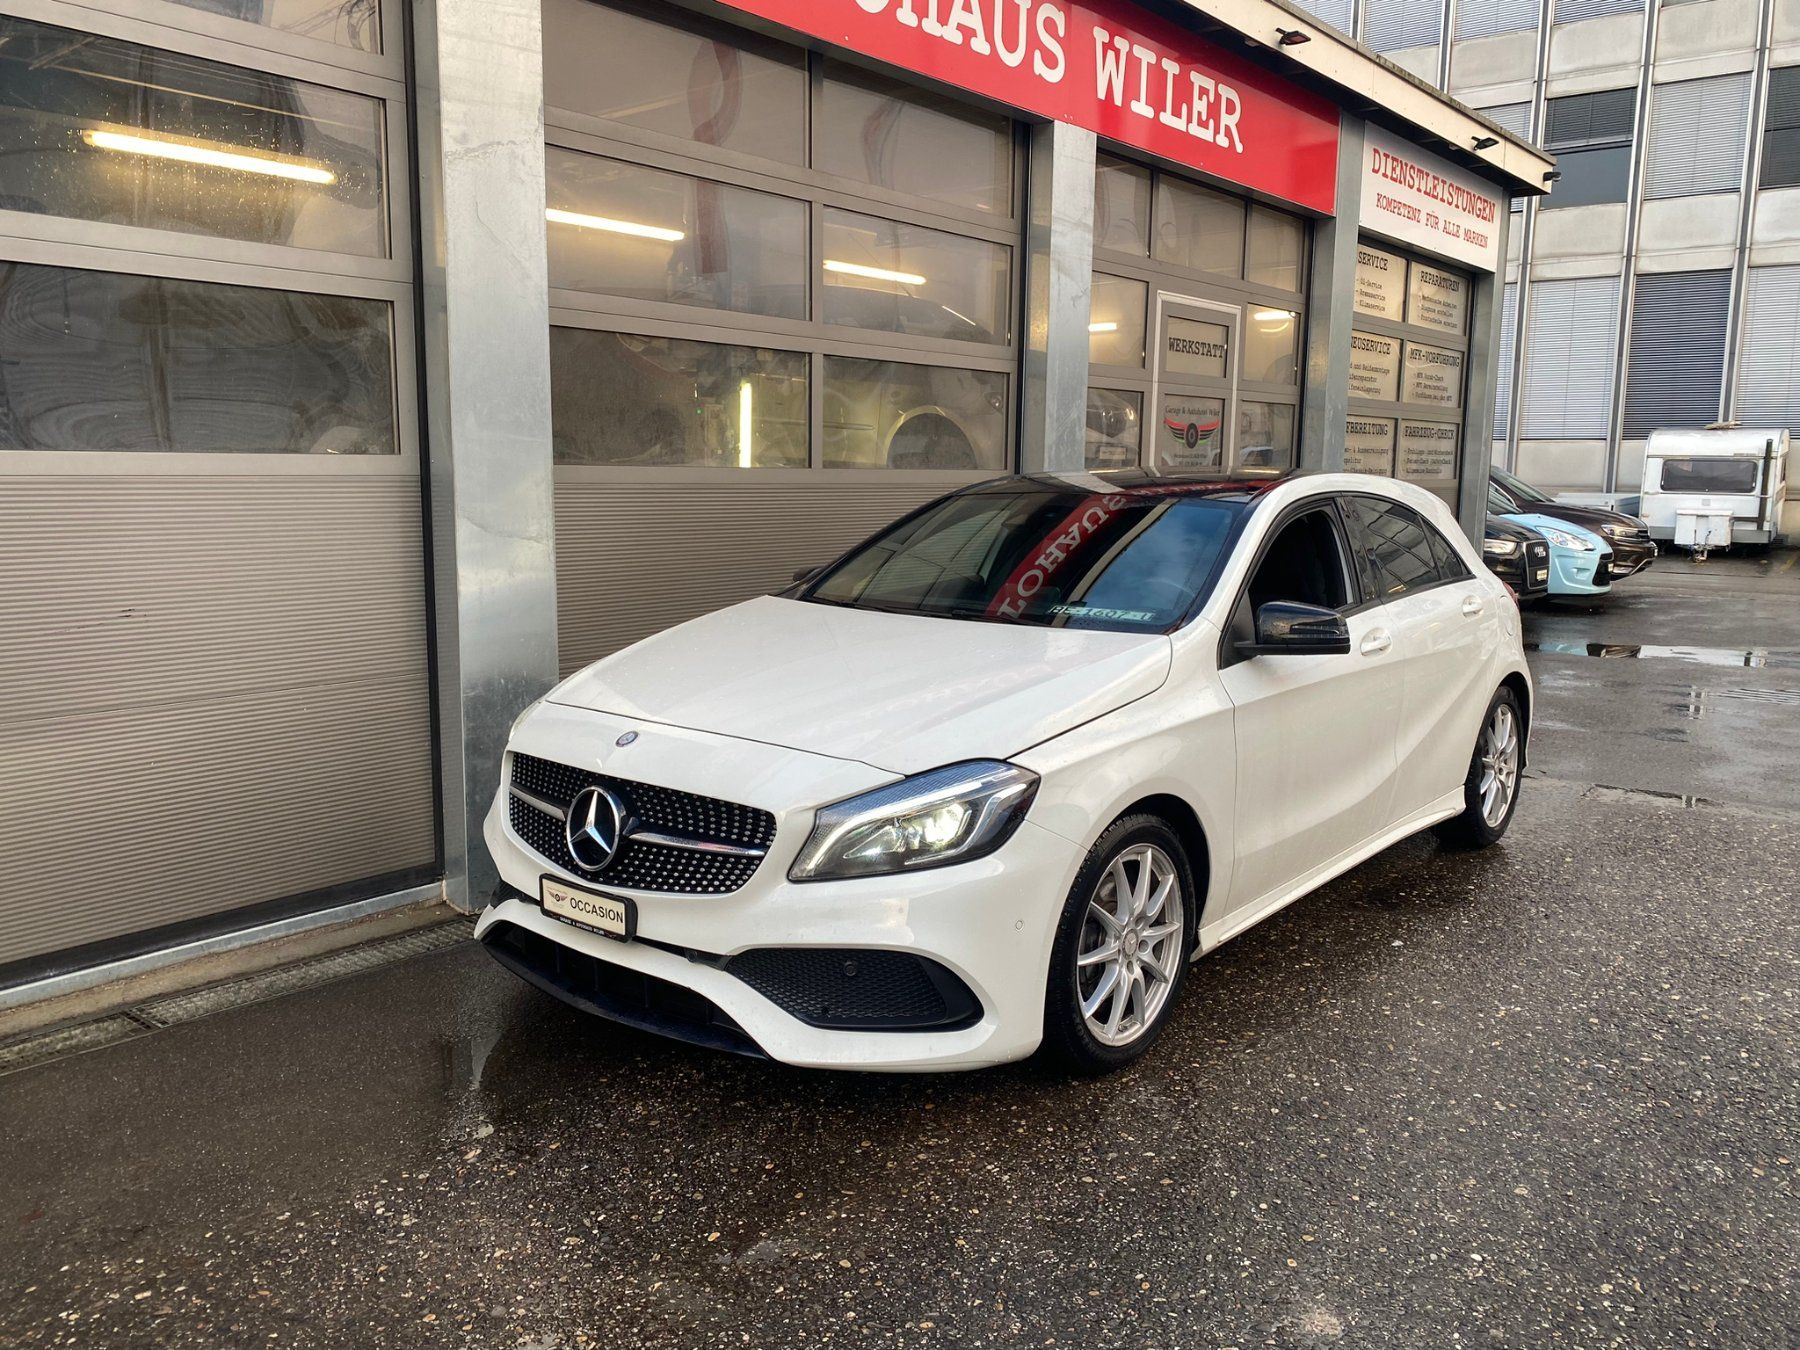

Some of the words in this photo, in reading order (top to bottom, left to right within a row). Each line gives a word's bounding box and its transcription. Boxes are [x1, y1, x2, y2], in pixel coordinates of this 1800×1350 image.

[854, 0, 1066, 84] AUS
[1092, 25, 1244, 154] WILER
[1371, 147, 1496, 224] DIENSTLEISTUNGEN
[1375, 192, 1422, 223] KOMPETENZ
[1425, 210, 1440, 231] FÜR
[1442, 219, 1461, 239] ALLE
[1463, 227, 1489, 249] MARKEN
[1357, 251, 1389, 271] SERVICE
[1420, 270, 1460, 292] REPARATUREN
[1168, 336, 1225, 359] WERKSTATT
[570, 898, 623, 923] OCCASION
